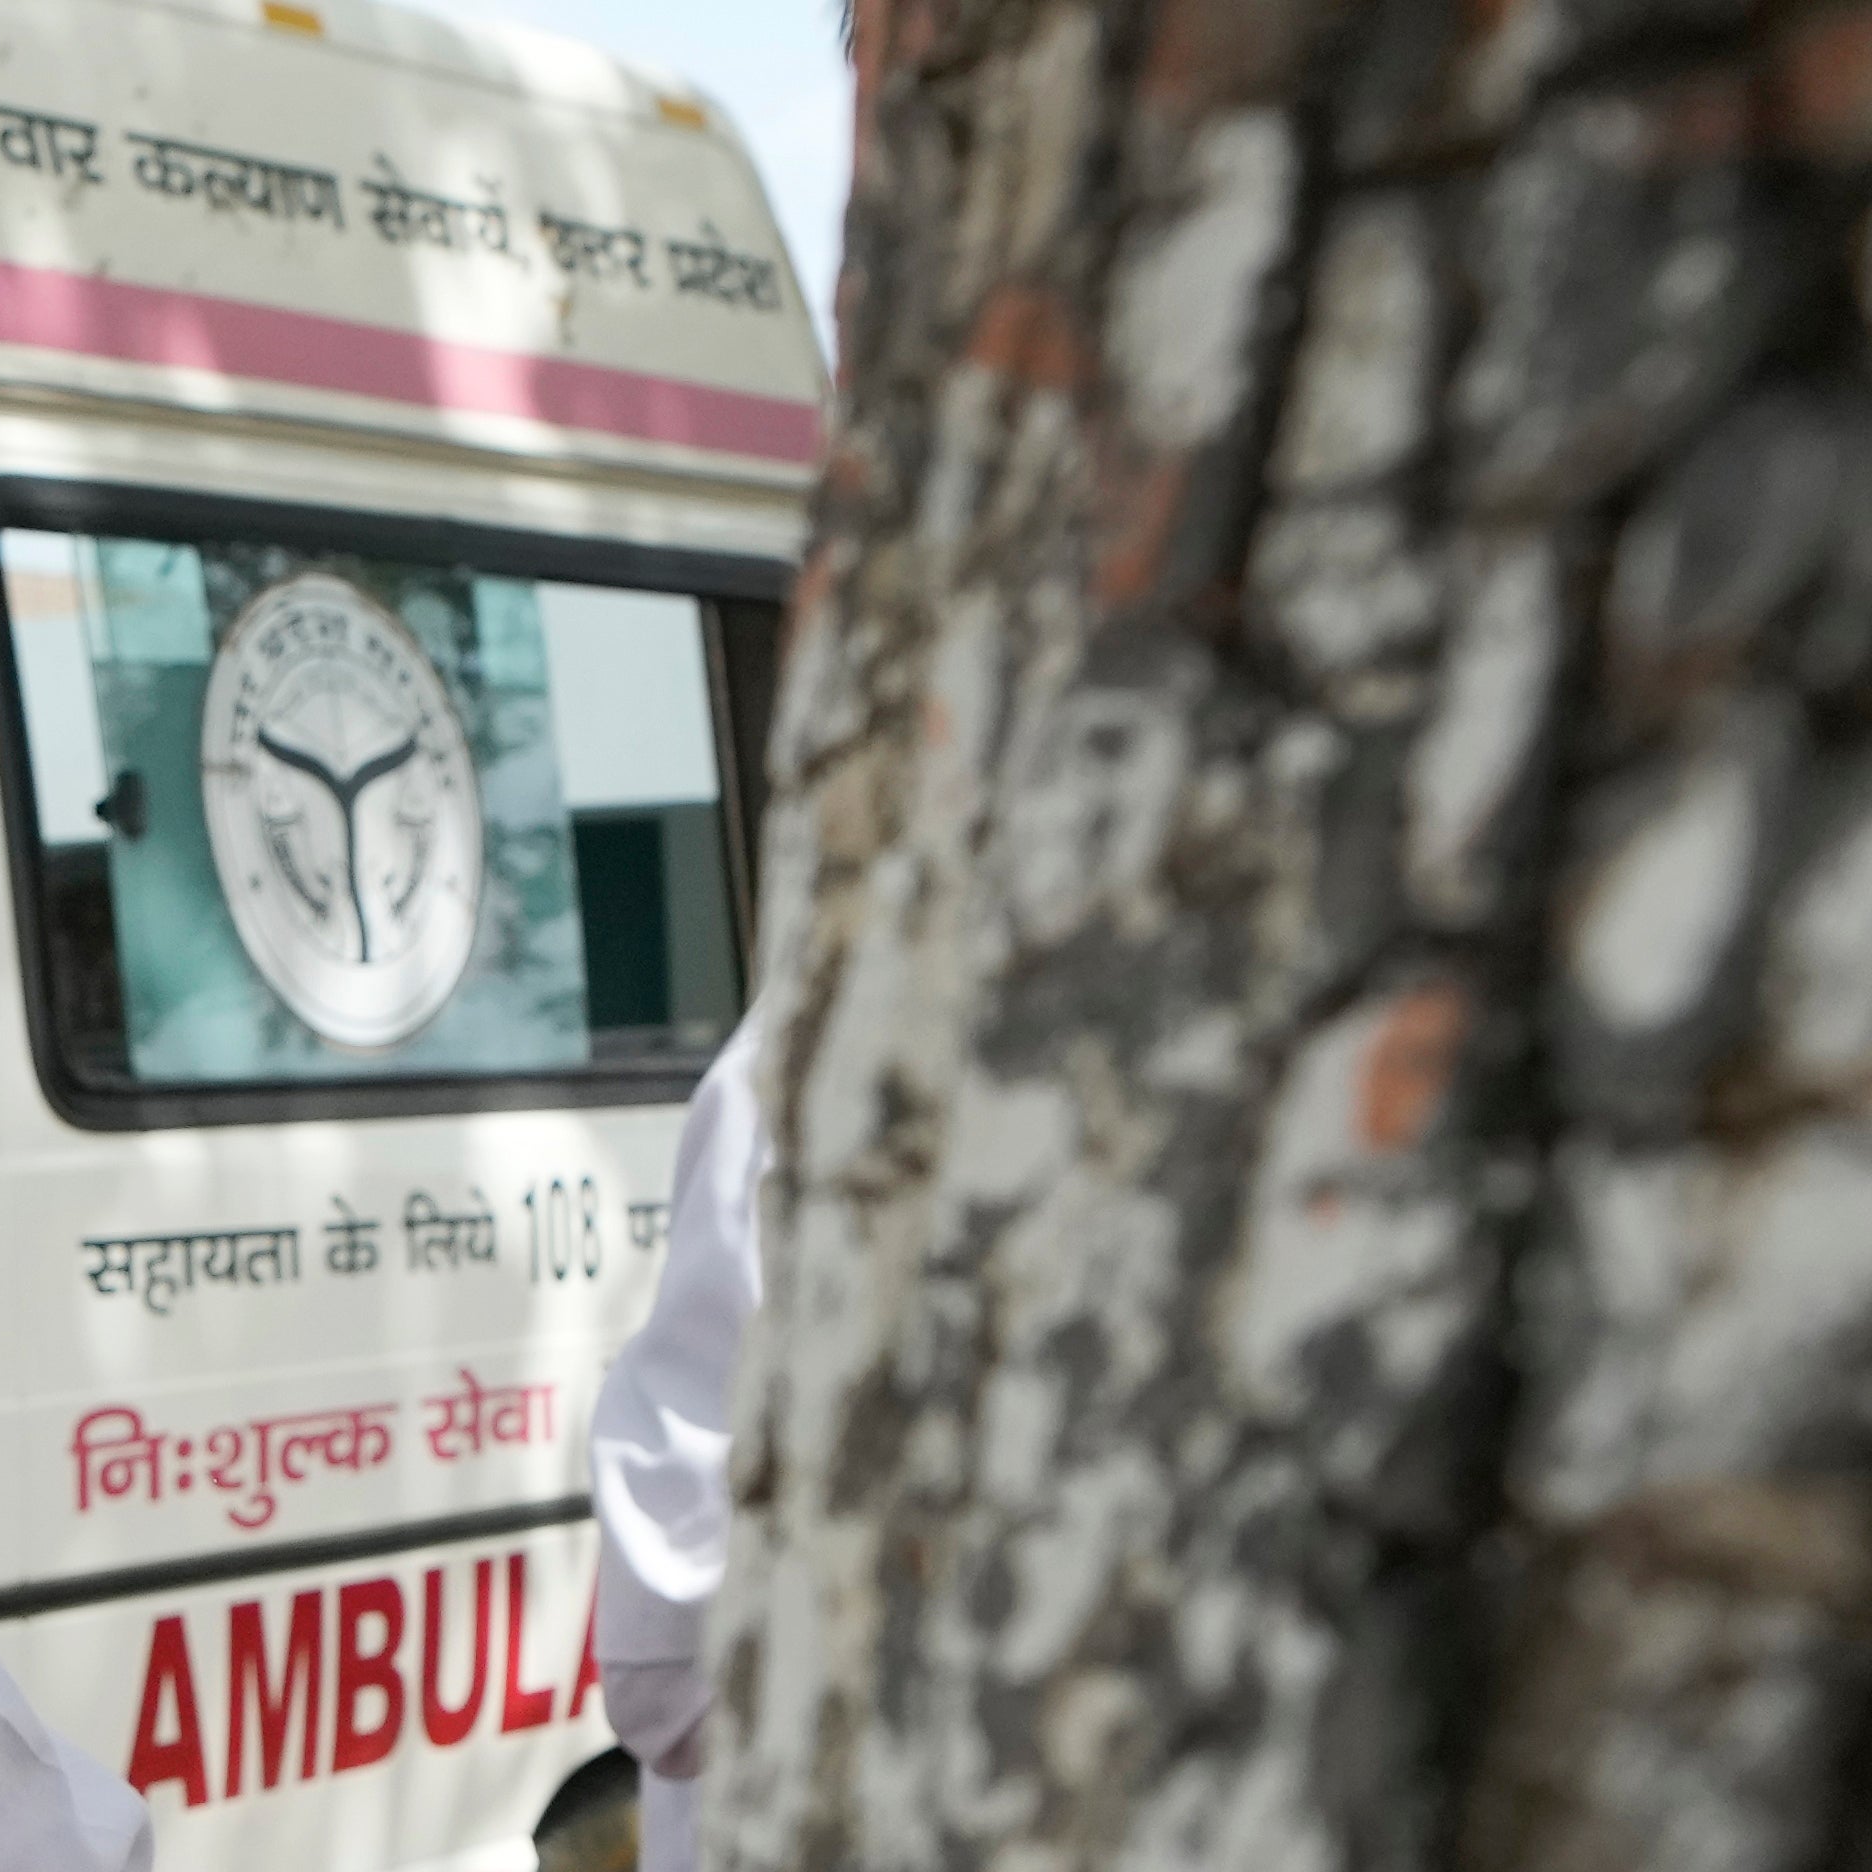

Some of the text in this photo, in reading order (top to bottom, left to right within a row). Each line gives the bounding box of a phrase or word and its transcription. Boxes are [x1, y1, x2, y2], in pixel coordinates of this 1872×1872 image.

[124, 130, 346, 232] कल्याण
[78, 1225, 301, 1316] सहायता
[323, 1194, 382, 1277] के
[402, 1190, 498, 1272] लिये
[521, 1175, 601, 1282] 108
[421, 1367, 558, 1462] सेवा
